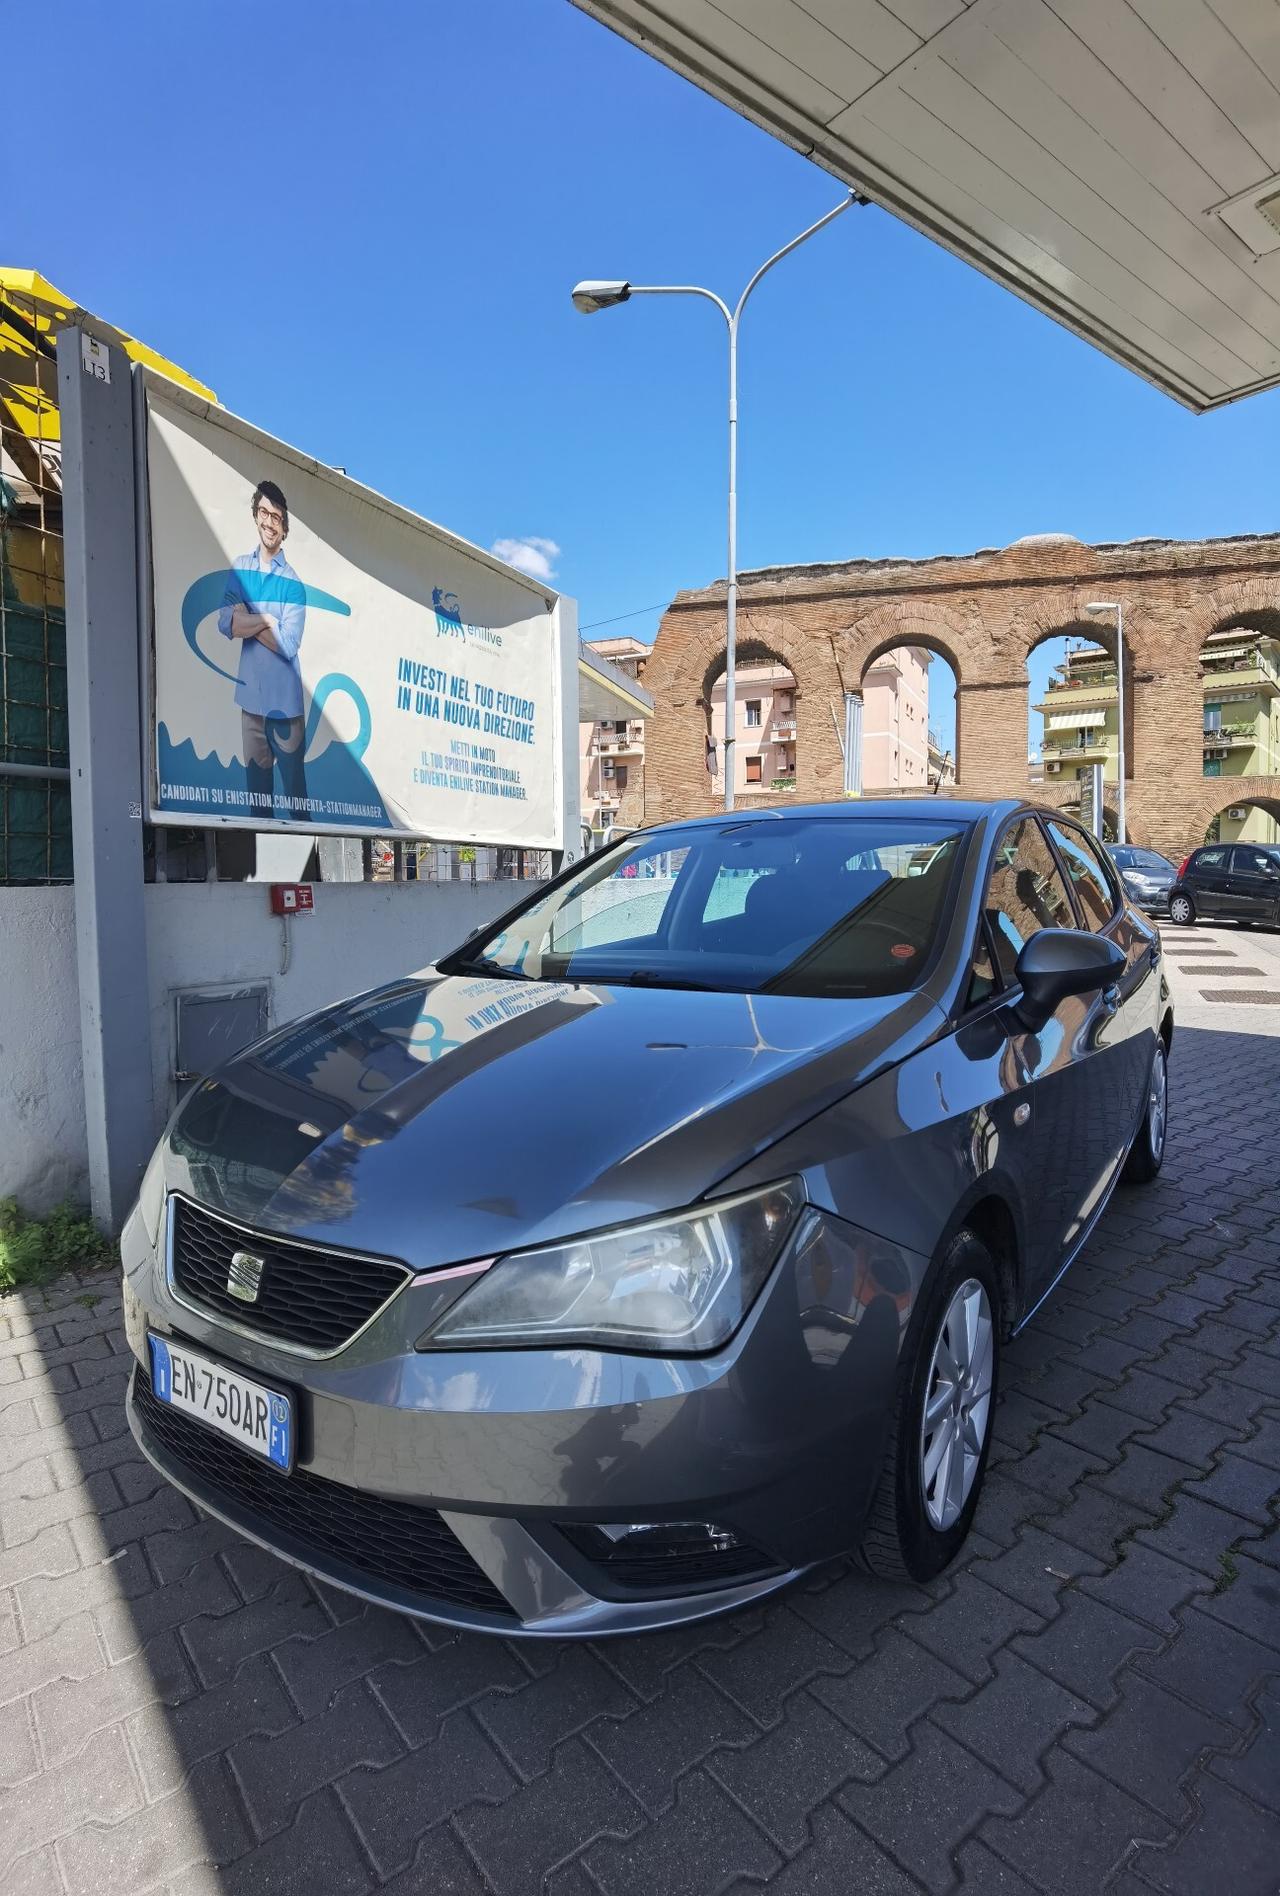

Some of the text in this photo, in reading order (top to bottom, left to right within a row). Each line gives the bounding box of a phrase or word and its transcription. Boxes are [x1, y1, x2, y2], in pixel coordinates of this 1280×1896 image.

[467, 624, 503, 647] enilive
[398, 657, 535, 721] INVESTI NEL TUO FUTURO
[397, 685, 535, 745] IN UNA NUOVA DIREZIONE.
[421, 751, 521, 784] IL TUO SPIRITO IMPRENDITORIALE
[450, 739, 496, 763] METTI IN MOTO
[161, 783, 382, 818] CANDIDATI SU ENISTATION.COM/DIVENTA-STATIONMANAGER
[413, 768, 528, 801] E DIVENTA ENILIVE STATION MANAGER.
[160, 1369, 165, 1393] I
[171, 1353, 268, 1441] EN 750AR
